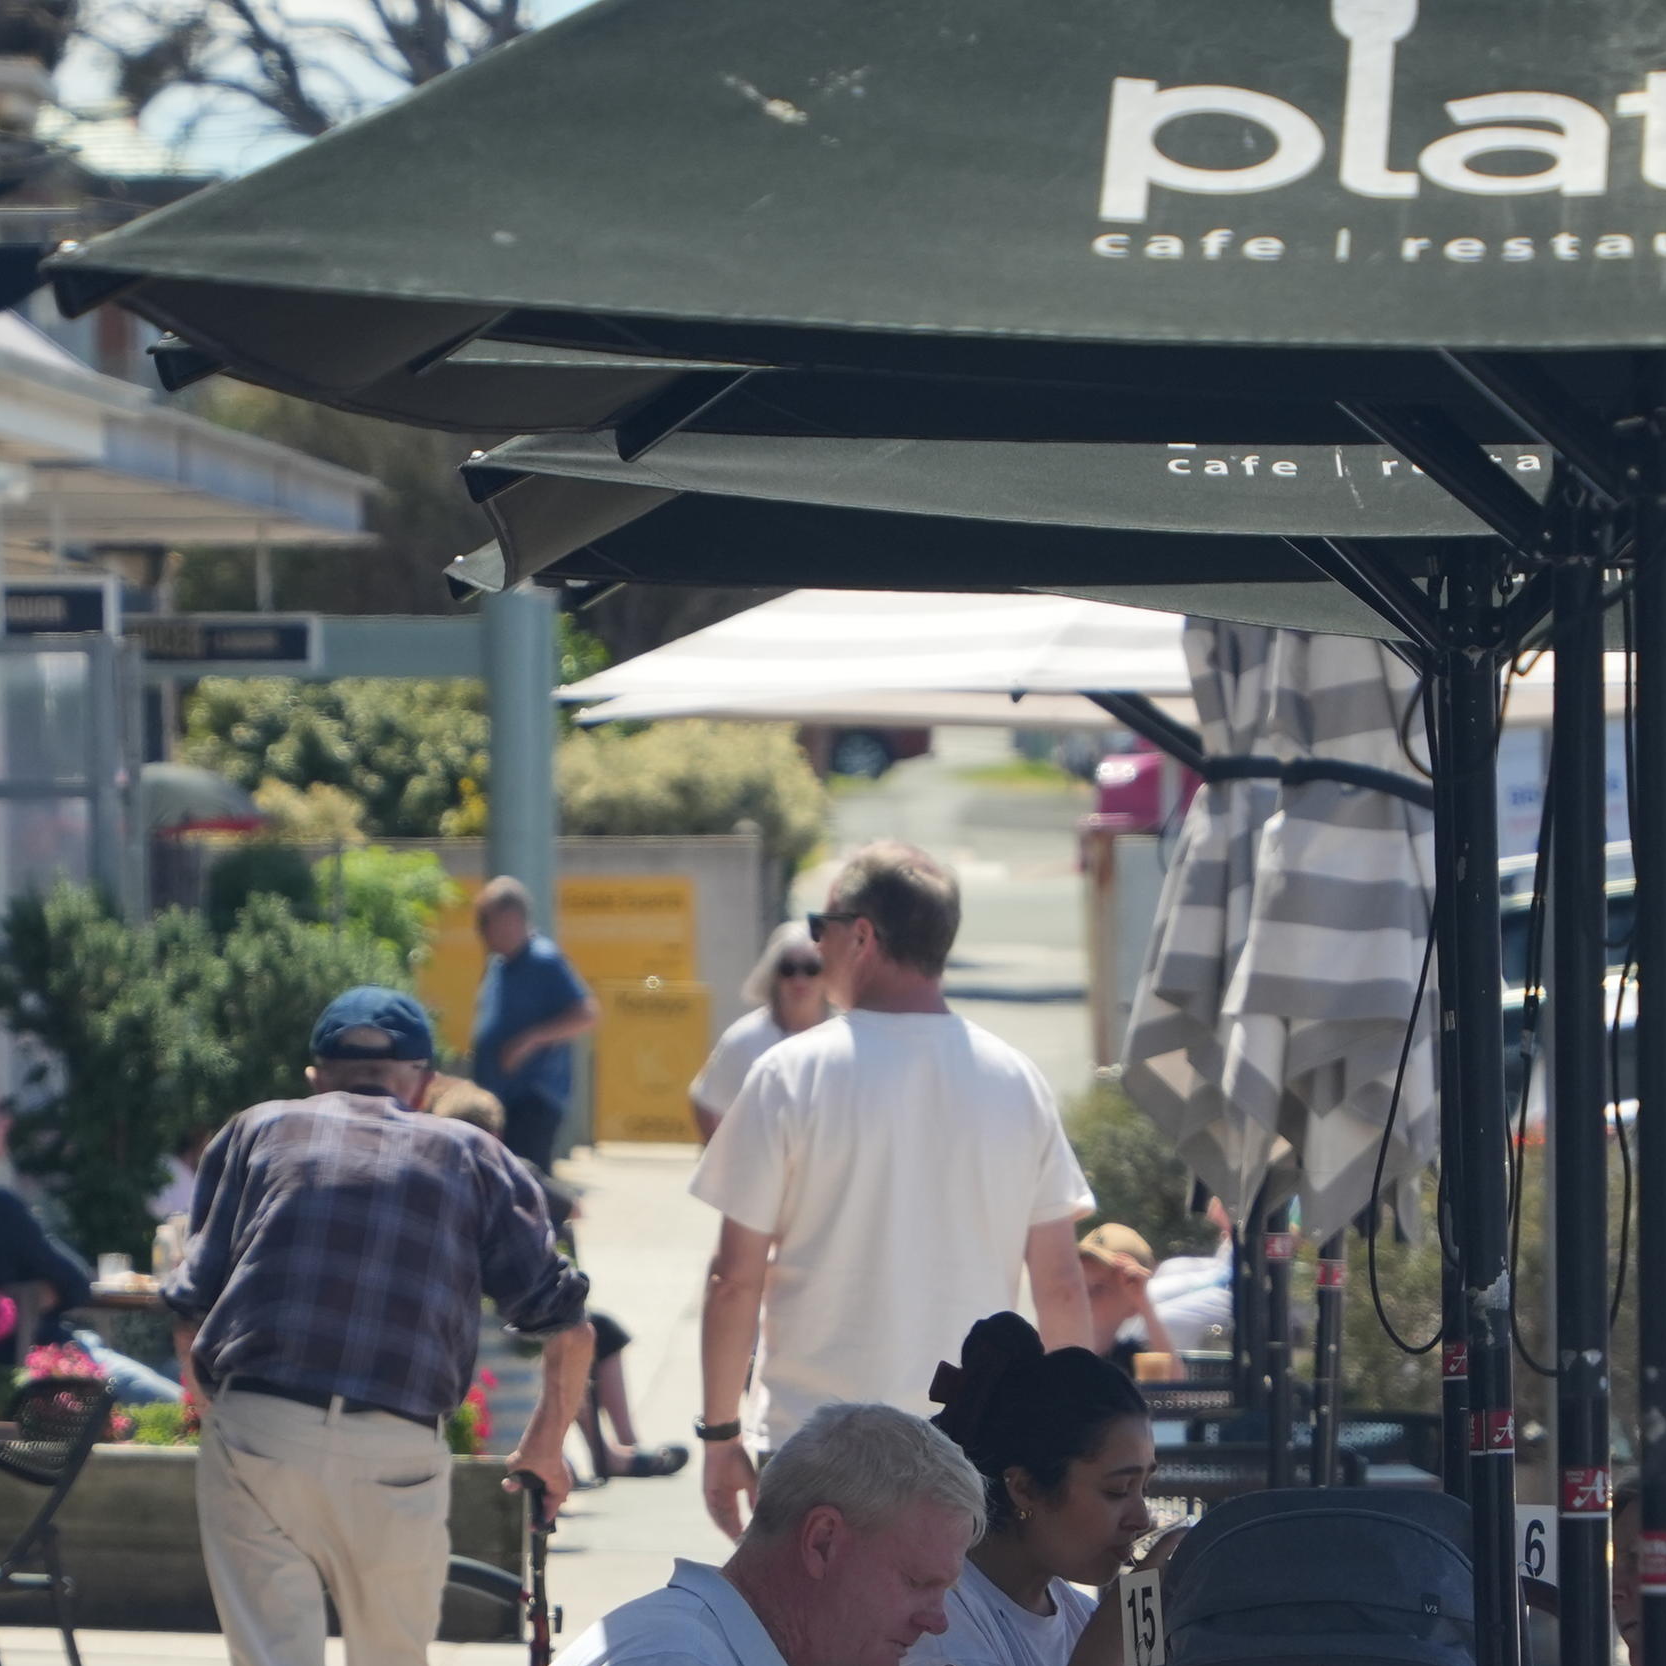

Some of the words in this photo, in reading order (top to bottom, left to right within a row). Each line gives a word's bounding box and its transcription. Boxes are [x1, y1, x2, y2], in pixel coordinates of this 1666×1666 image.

[1092, 227, 1286, 262] cafe
[1166, 454, 1299, 476] cafe
[1524, 1518, 1546, 1577] 6
[1127, 1585, 1156, 1650] 15
